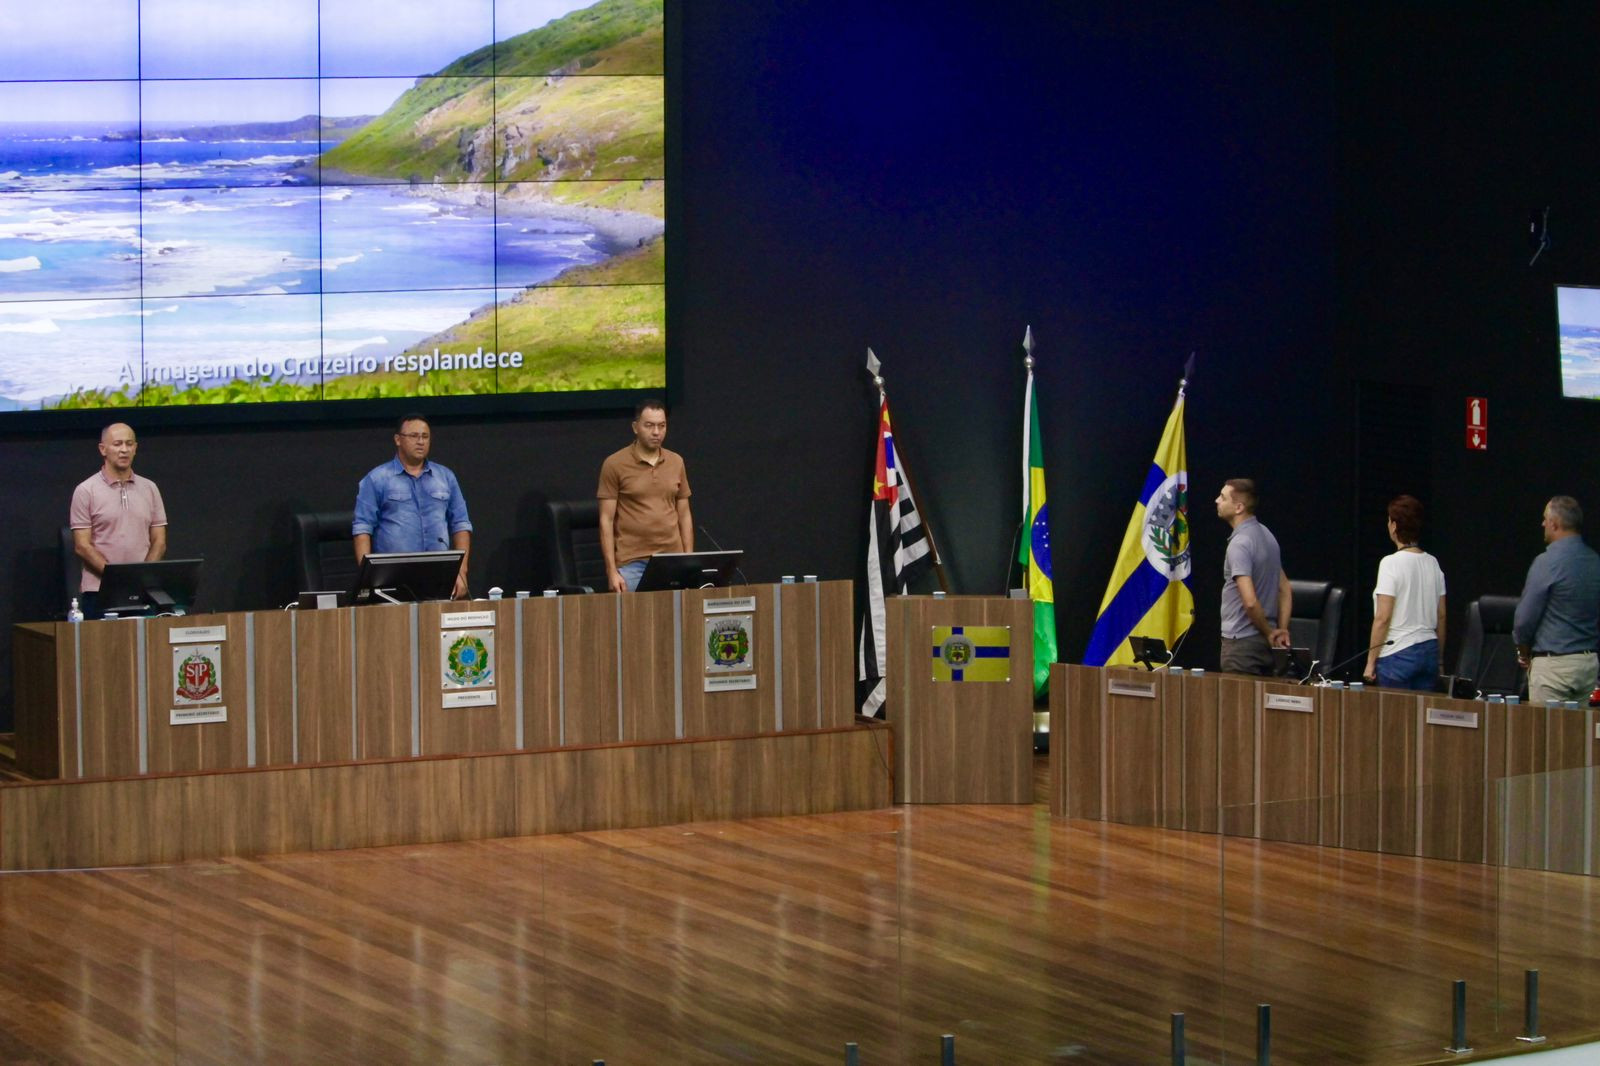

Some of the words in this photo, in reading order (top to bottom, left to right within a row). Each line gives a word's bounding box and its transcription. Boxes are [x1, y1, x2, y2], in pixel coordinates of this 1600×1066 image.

[118, 361, 136, 383] A
[143, 361, 237, 385] imagem
[243, 357, 274, 377] do
[280, 354, 378, 376] Cruzeiro
[384, 347, 524, 377] resplandece
